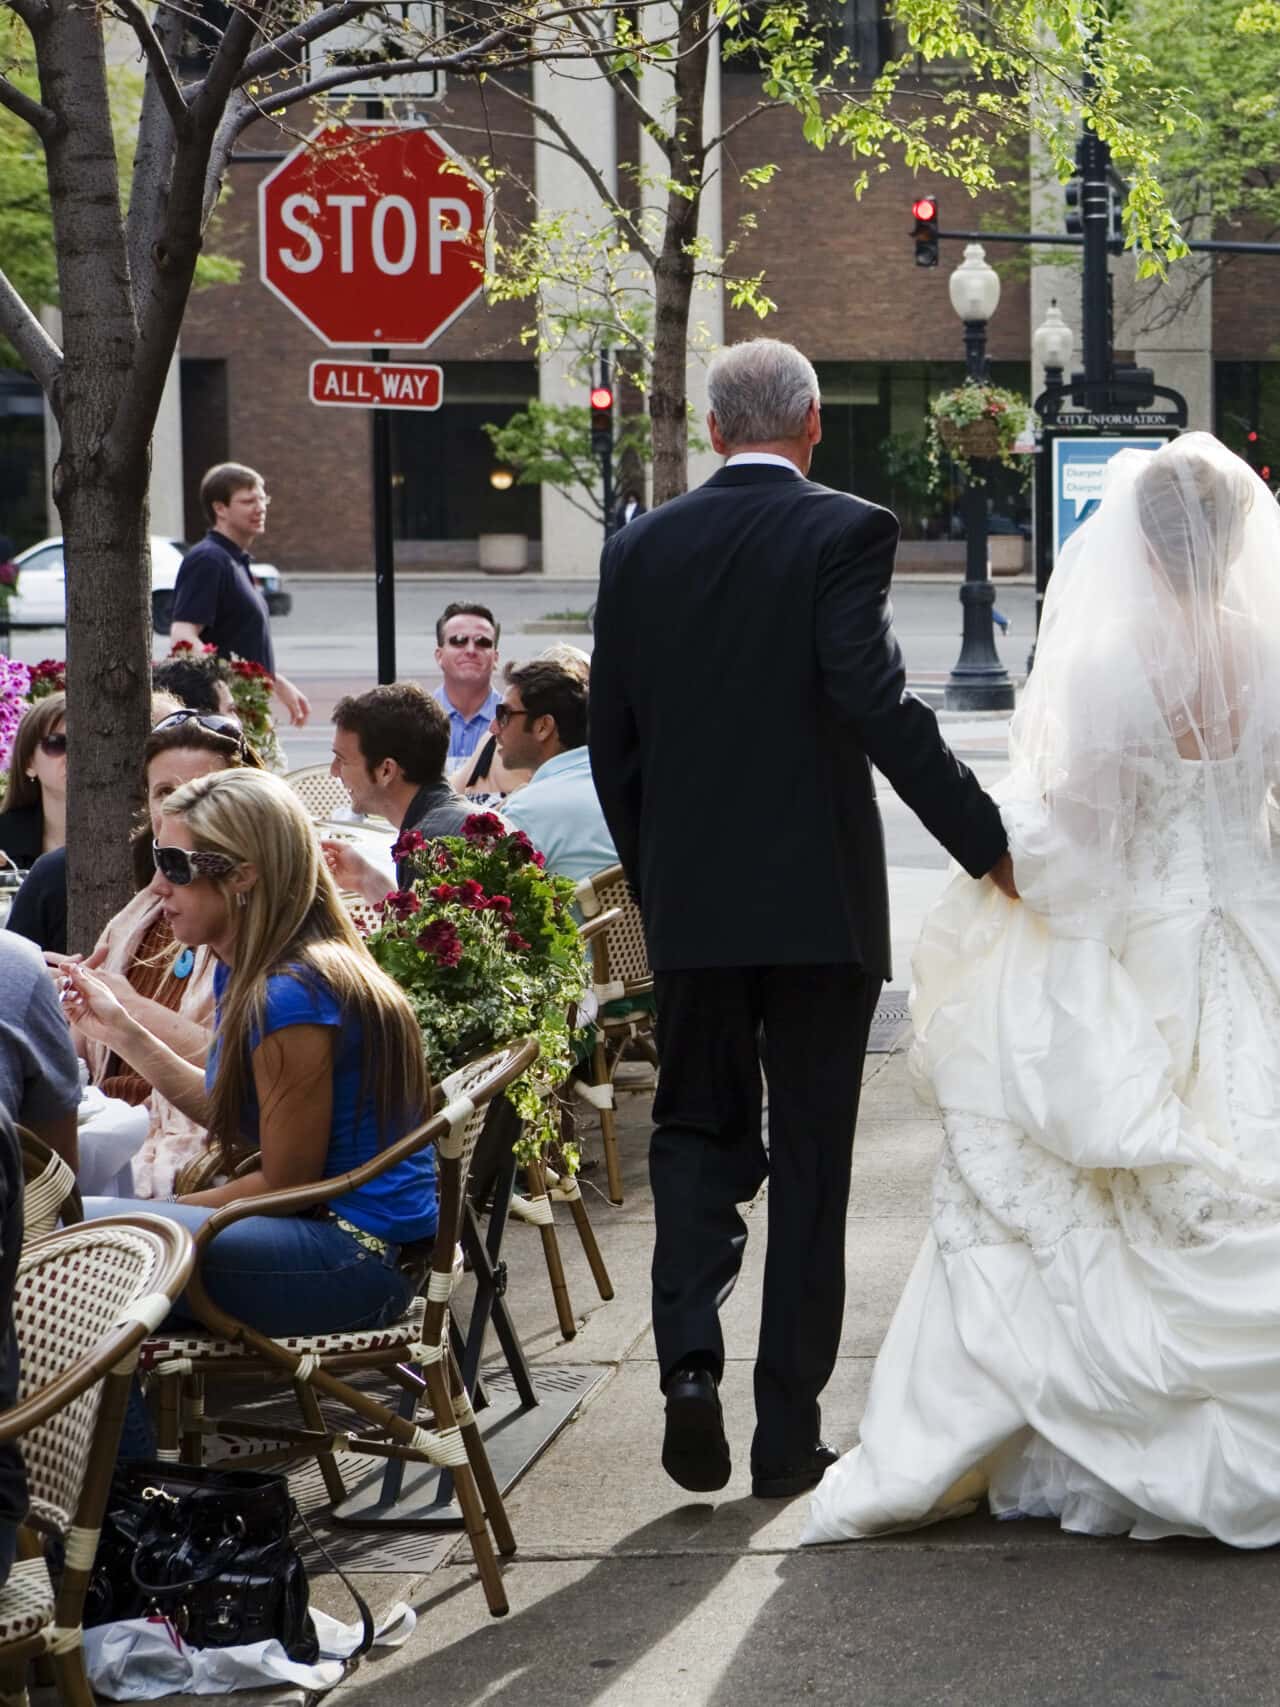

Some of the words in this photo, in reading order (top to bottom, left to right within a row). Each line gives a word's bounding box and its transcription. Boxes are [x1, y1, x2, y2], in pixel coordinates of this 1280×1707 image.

[278, 193, 472, 276] STOP
[324, 371, 371, 397] ALL
[382, 373, 429, 399] WAY
[1057, 415, 1084, 425] CITY
[1088, 415, 1166, 425] INFORMATION
[1067, 469, 1103, 479] Charged
[1067, 483, 1103, 493] Charged
